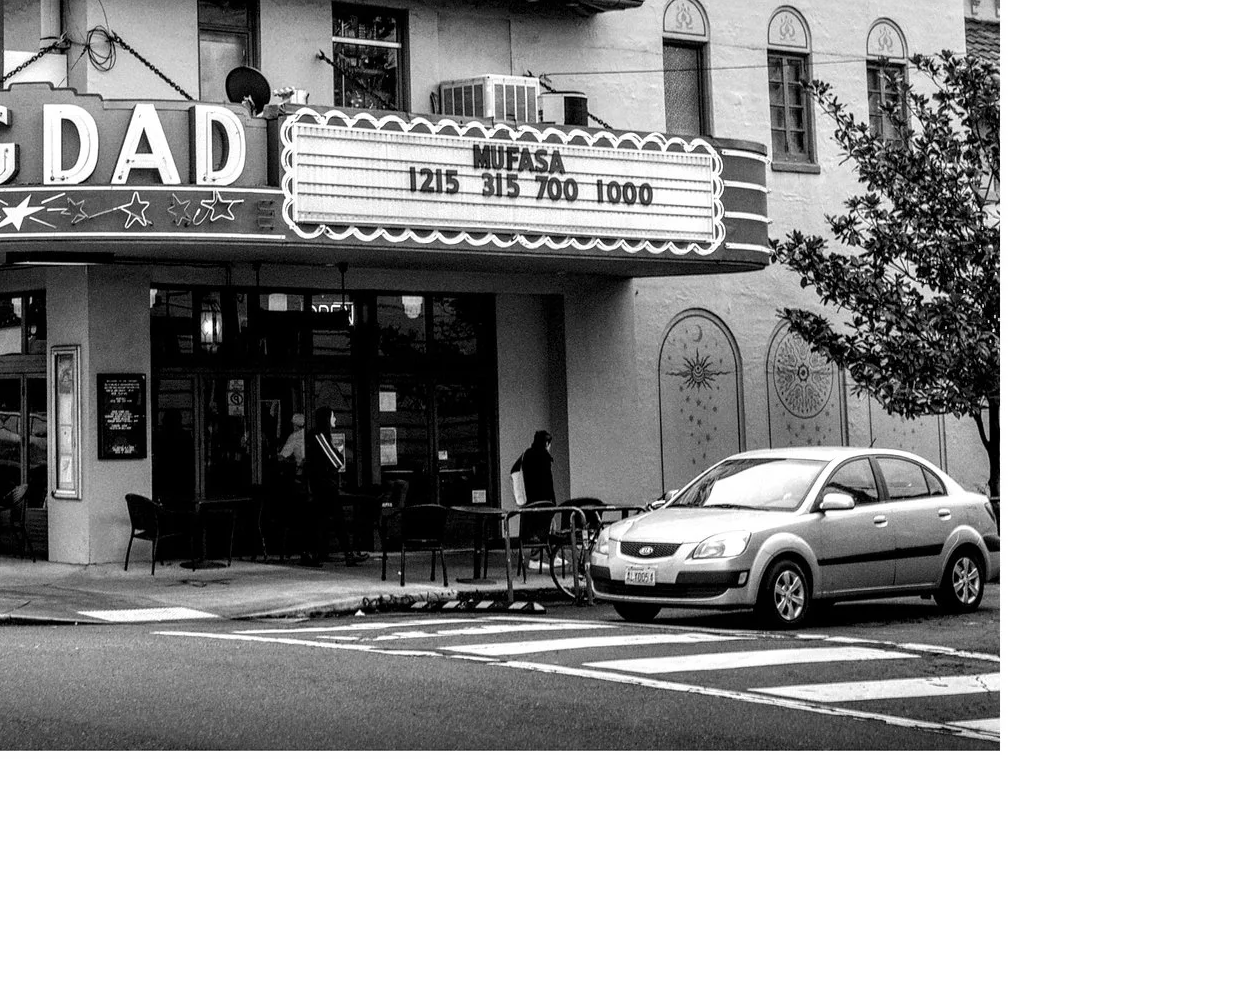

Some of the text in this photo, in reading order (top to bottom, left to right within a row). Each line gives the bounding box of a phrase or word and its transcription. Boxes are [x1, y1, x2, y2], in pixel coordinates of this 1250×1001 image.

[473, 144, 566, 174] MUFASA
[409, 166, 653, 206] 1215 315 700 1000
